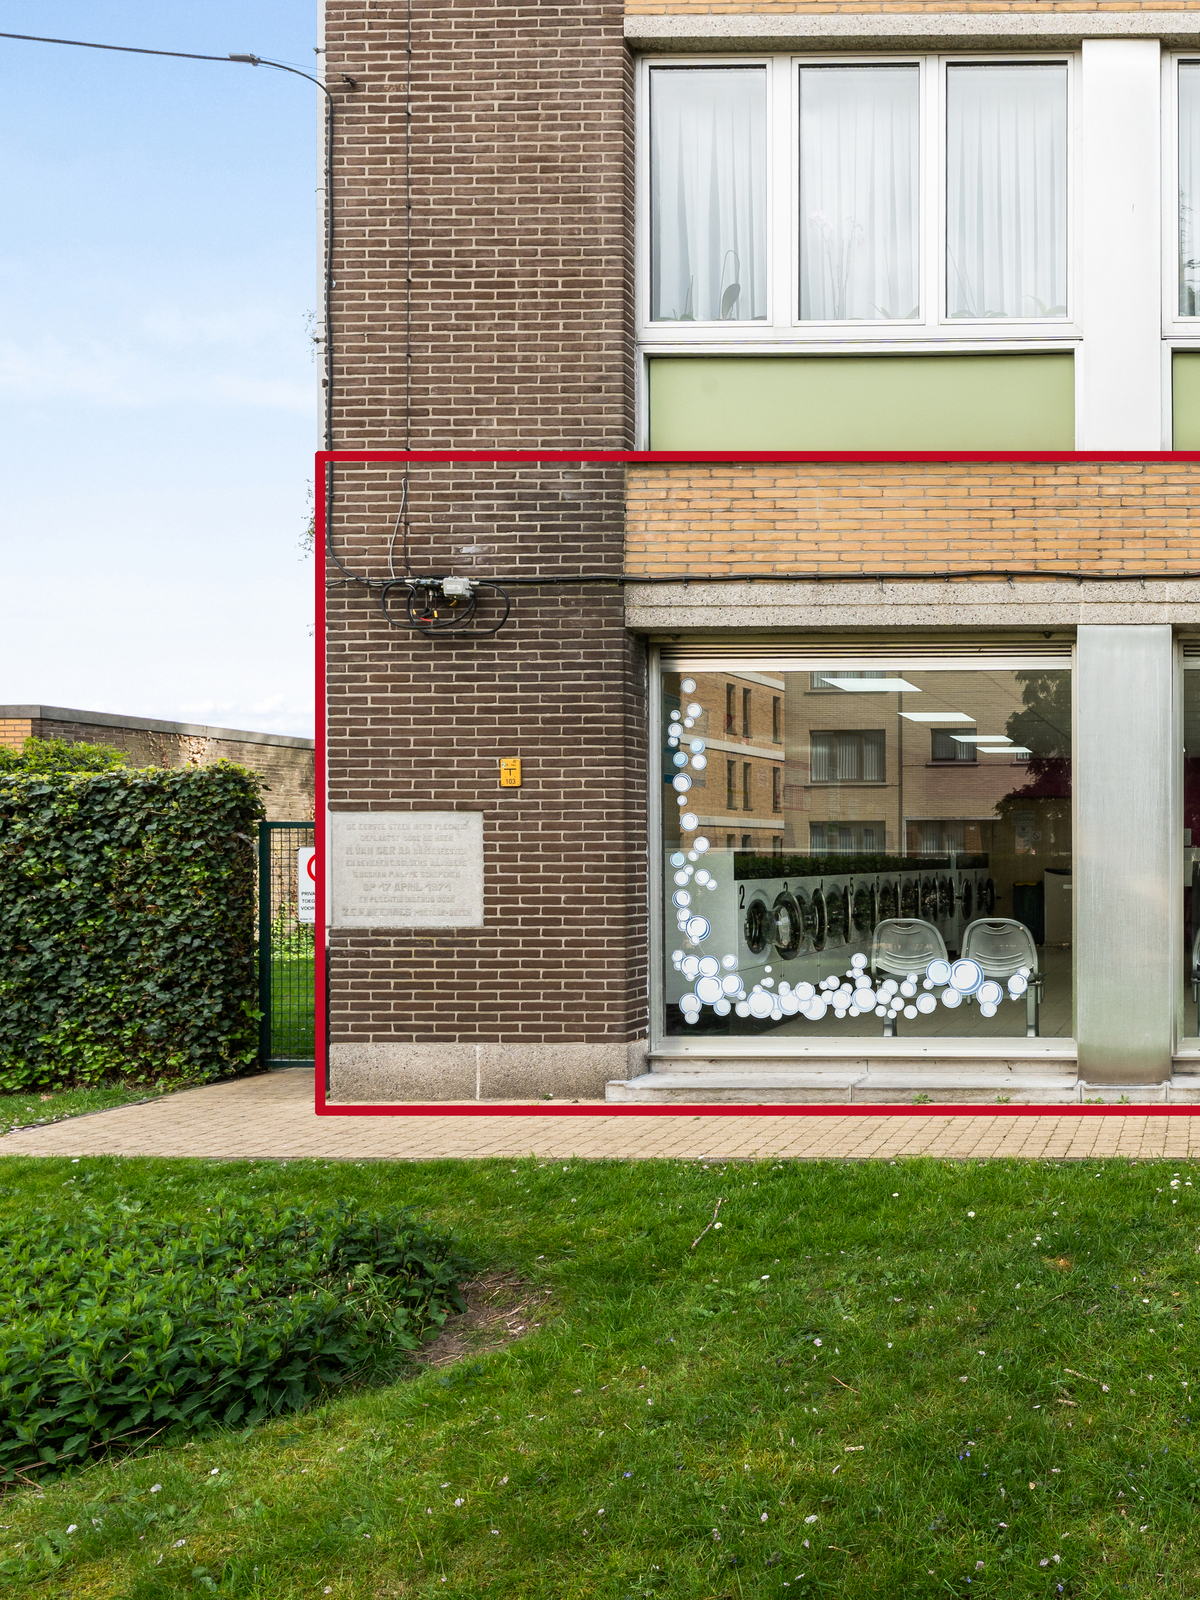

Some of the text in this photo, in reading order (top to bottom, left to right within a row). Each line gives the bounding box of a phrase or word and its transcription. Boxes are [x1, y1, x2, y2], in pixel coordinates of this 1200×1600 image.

[356, 846, 374, 855] VAN
[376, 846, 396, 855] DER
[398, 846, 410, 855] AA
[363, 883, 376, 892] OP
[378, 883, 392, 892] 17
[394, 883, 422, 892] APRIL
[739, 885, 745, 909] 2
